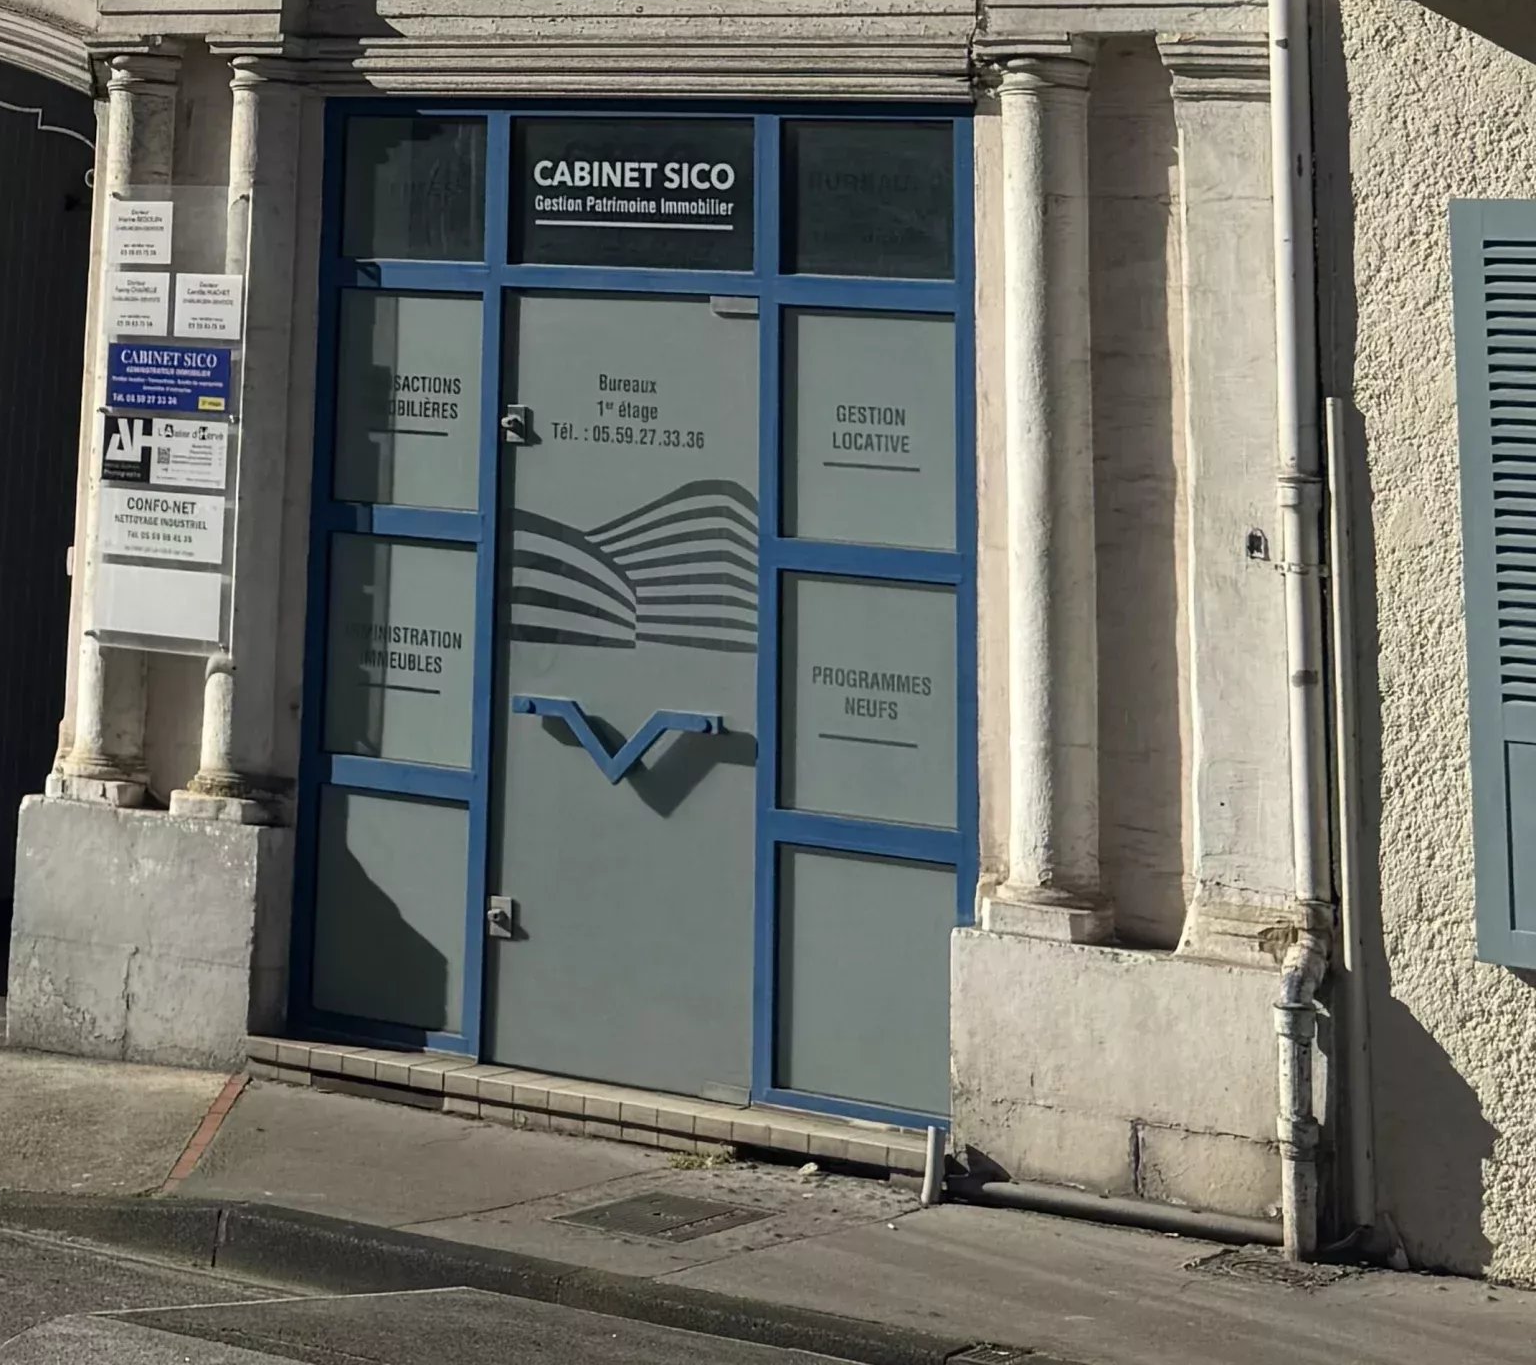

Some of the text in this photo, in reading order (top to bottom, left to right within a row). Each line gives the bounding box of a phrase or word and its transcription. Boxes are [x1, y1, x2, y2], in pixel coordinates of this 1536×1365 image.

[533, 160, 735, 191] CABINET SICO
[535, 195, 735, 216] Gestion Patrimoine Immobilier
[120, 349, 218, 369] CABINET SICO
[599, 373, 657, 394] Bureaux
[618, 401, 659, 423] étage
[836, 405, 906, 426] GESTION
[551, 422, 579, 441] Tél.
[592, 424, 705, 449] 05.59.27.33.36
[832, 431, 910, 453] LOCATIVE
[127, 496, 197, 515] CONFO-NET
[114, 514, 159, 526] NETTOYAGE
[812, 665, 932, 696] PROGRAMMES
[845, 697, 898, 720] NEUFS
